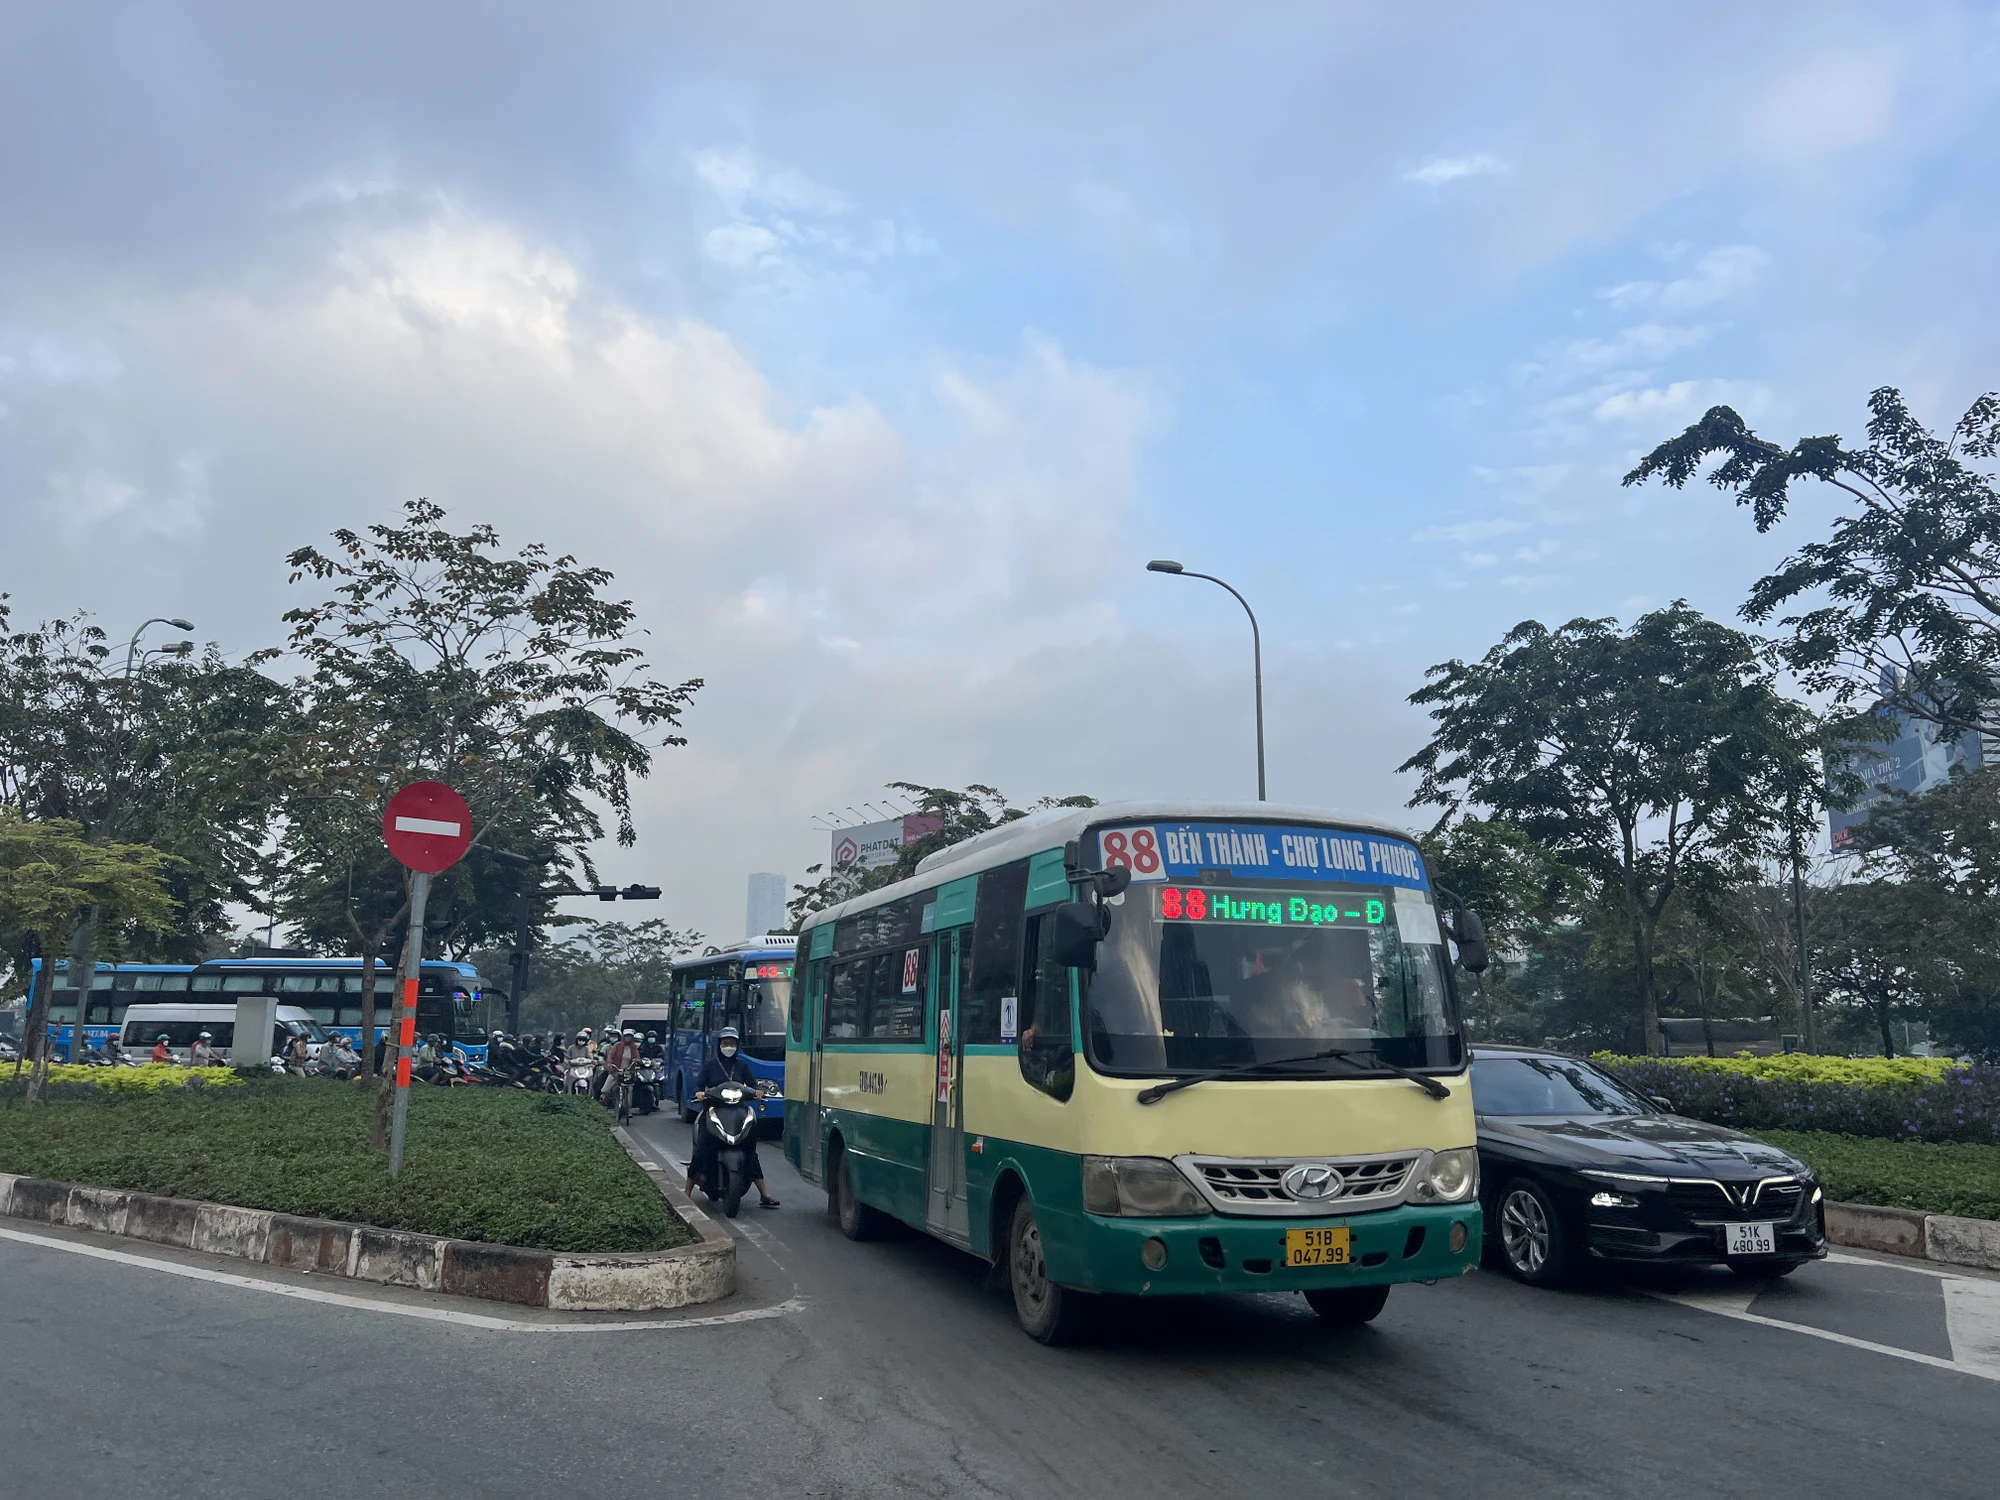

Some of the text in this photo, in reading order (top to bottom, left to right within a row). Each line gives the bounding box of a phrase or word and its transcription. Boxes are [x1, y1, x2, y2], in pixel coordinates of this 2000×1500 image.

[1895, 756, 1901, 769] 2
[1104, 829, 1160, 874] 88
[1165, 825, 1204, 865] BẾN
[1206, 829, 1269, 866] THÀNH
[1281, 834, 1319, 874] CHỢ
[1321, 837, 1367, 872] LONG
[1368, 841, 1420, 881] PHƯỚC
[1162, 888, 1206, 920] 88
[1213, 894, 1282, 925] Hưng
[1289, 897, 1338, 926] Đạo
[904, 951, 917, 988] 88
[1305, 1231, 1333, 1247] 51B
[1739, 1225, 1761, 1239] 51K
[1732, 1239, 1770, 1253] 480.99
[1293, 1247, 1344, 1265] 047.99
